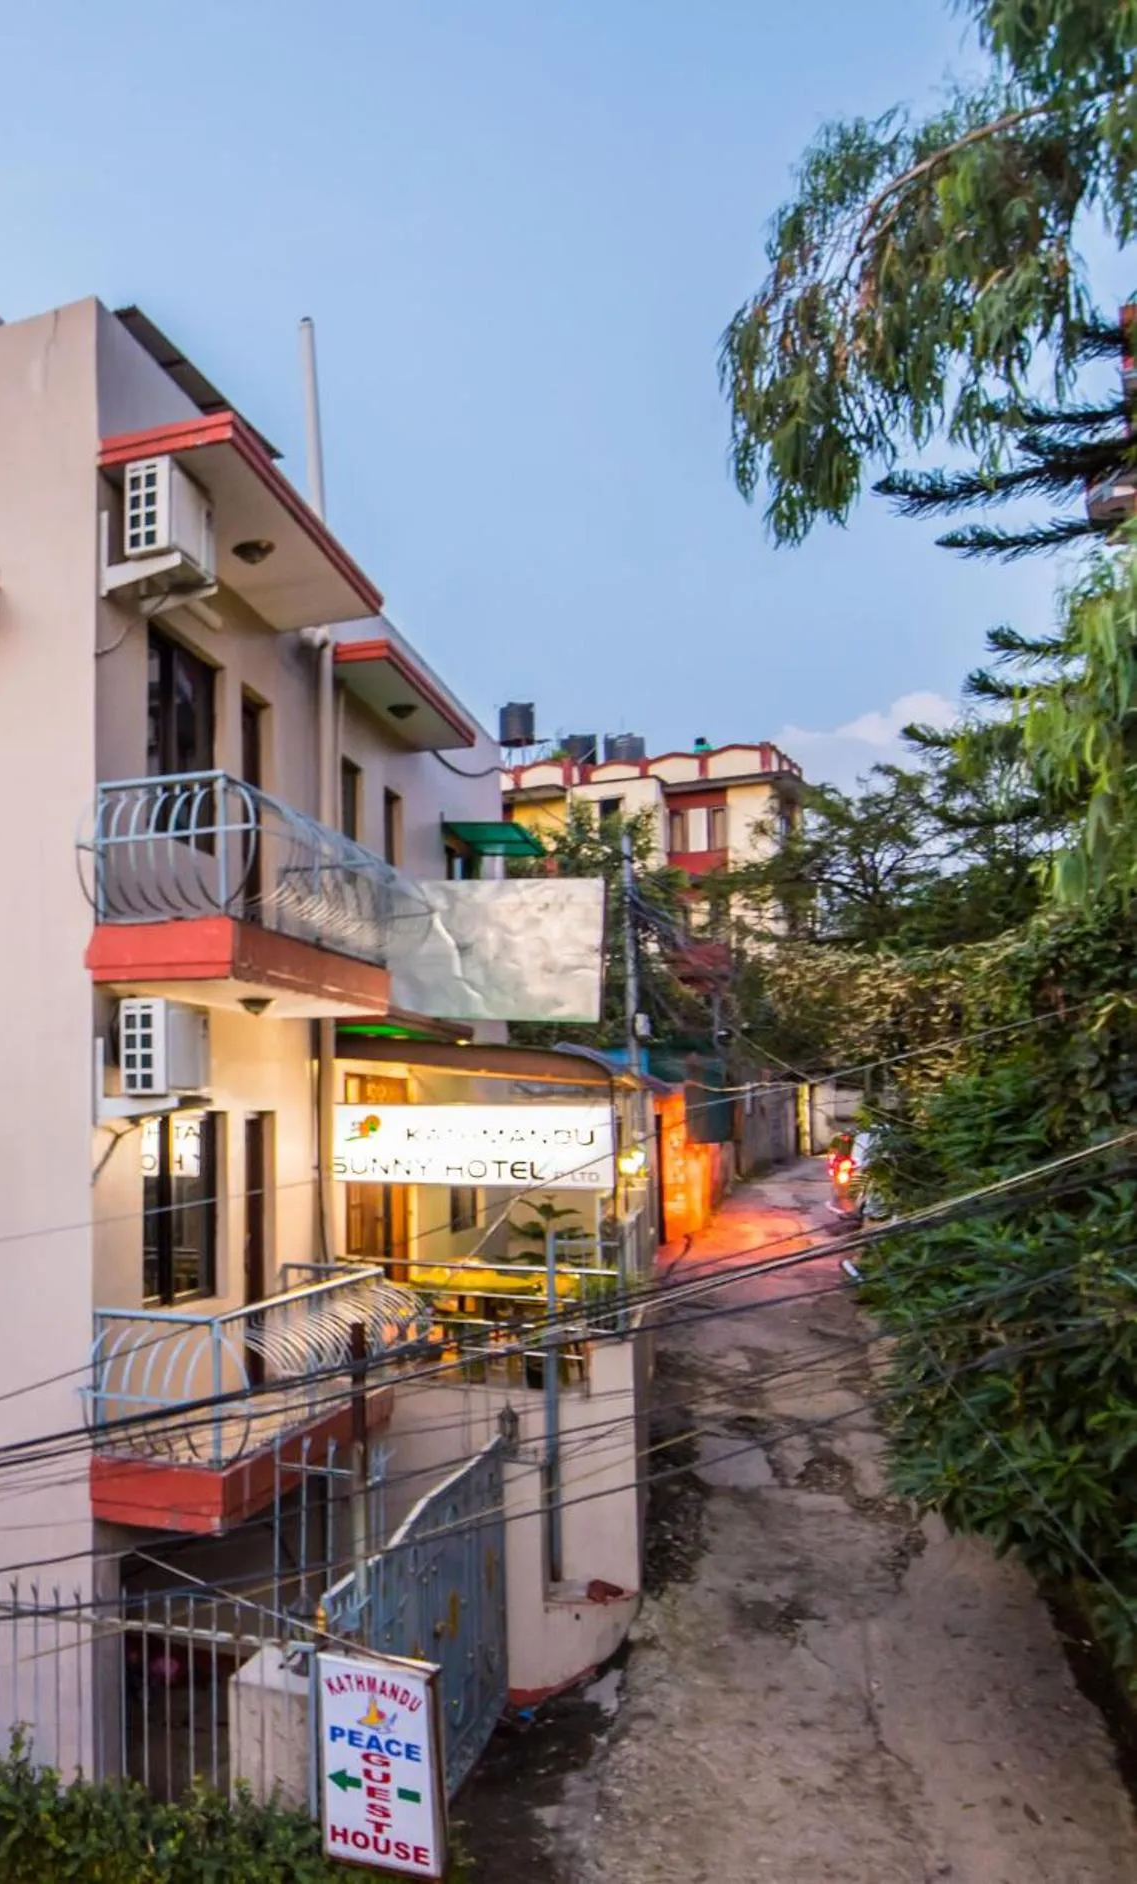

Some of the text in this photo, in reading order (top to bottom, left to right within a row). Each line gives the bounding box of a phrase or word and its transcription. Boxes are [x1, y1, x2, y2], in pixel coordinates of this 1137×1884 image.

[445, 1158, 546, 1181] HOTEL
[324, 1673, 423, 1713] KATHMANDU
[329, 1725, 422, 1763] PEACE
[360, 1752, 392, 1835] GUEST
[329, 1824, 431, 1867] HOUSE
